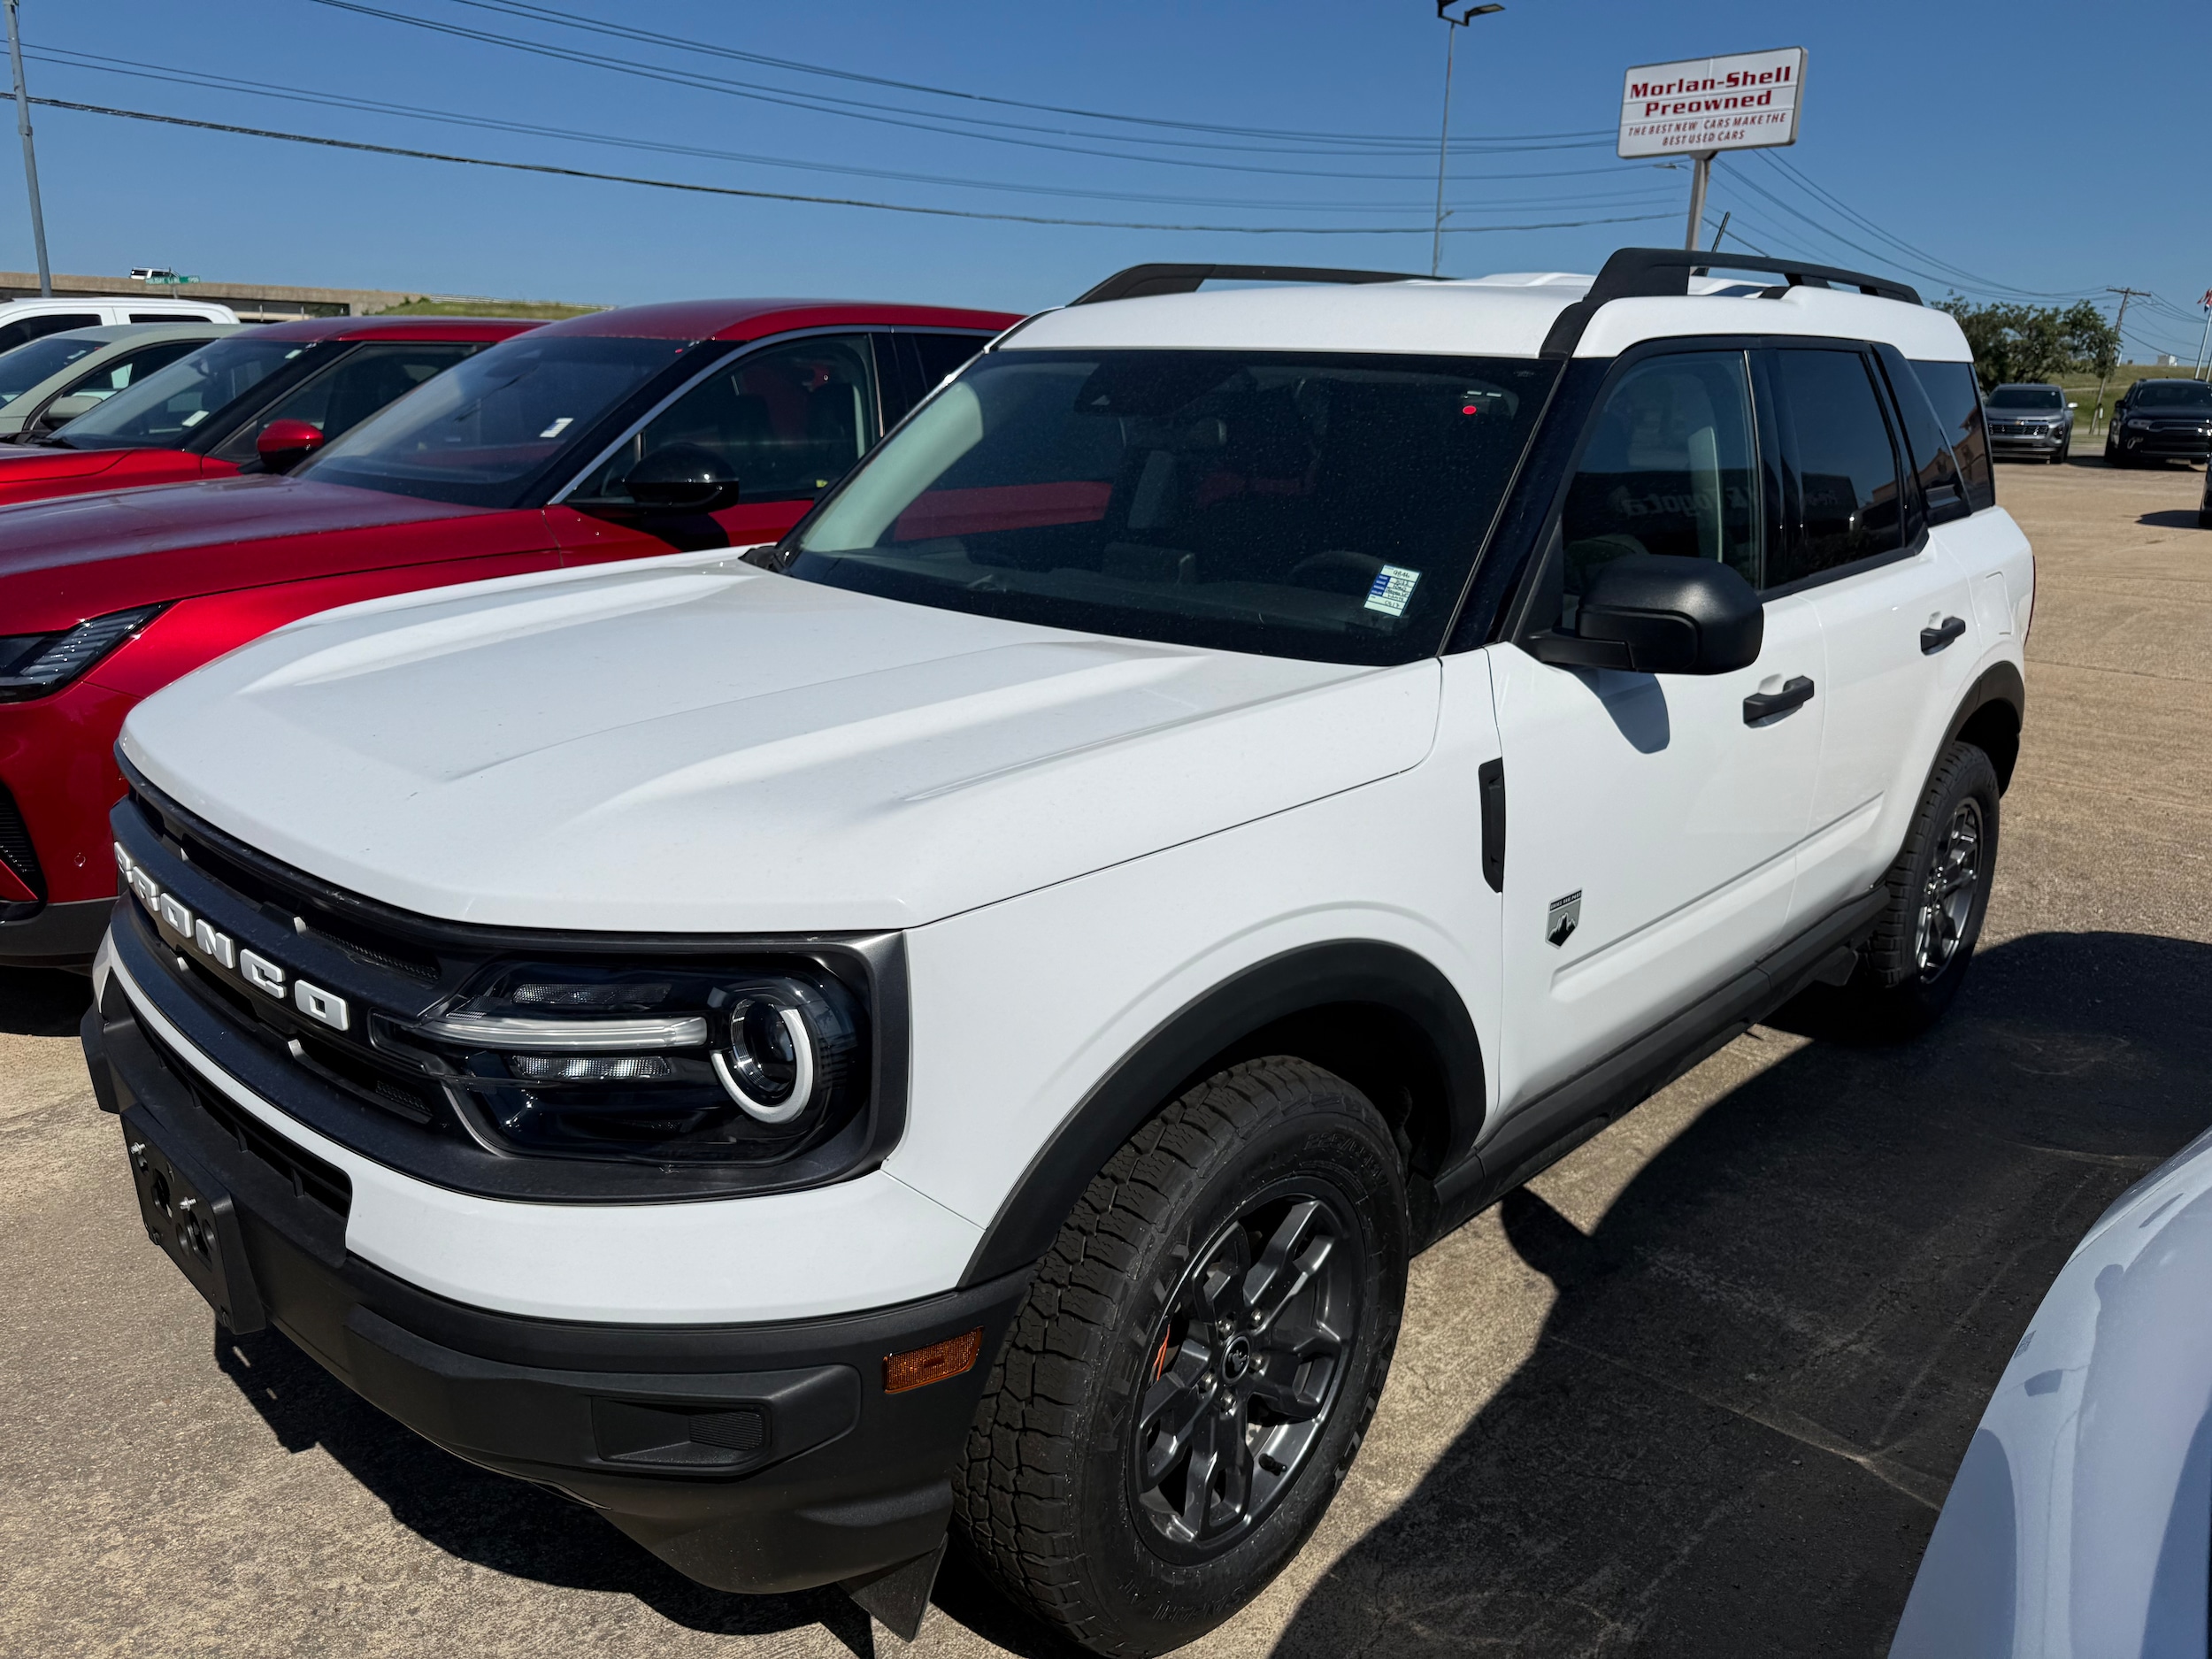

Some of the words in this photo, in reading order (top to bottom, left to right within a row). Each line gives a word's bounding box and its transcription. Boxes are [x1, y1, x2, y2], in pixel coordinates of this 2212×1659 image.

[1630, 65, 1791, 99] Morlan-Shell
[1645, 89, 1771, 118] Preowned
[1628, 126, 1647, 136] THE
[1648, 123, 1672, 135] BEST
[1675, 121, 1698, 131] NEW
[1703, 118, 1730, 129] CARS
[1732, 114, 1764, 127] MAKE
[1765, 112, 1786, 124] THE
[1663, 134, 1686, 146] BEST
[1688, 133, 1715, 144] USED
[1717, 129, 1745, 142] CARS
[114, 841, 350, 1032] BRONCO
